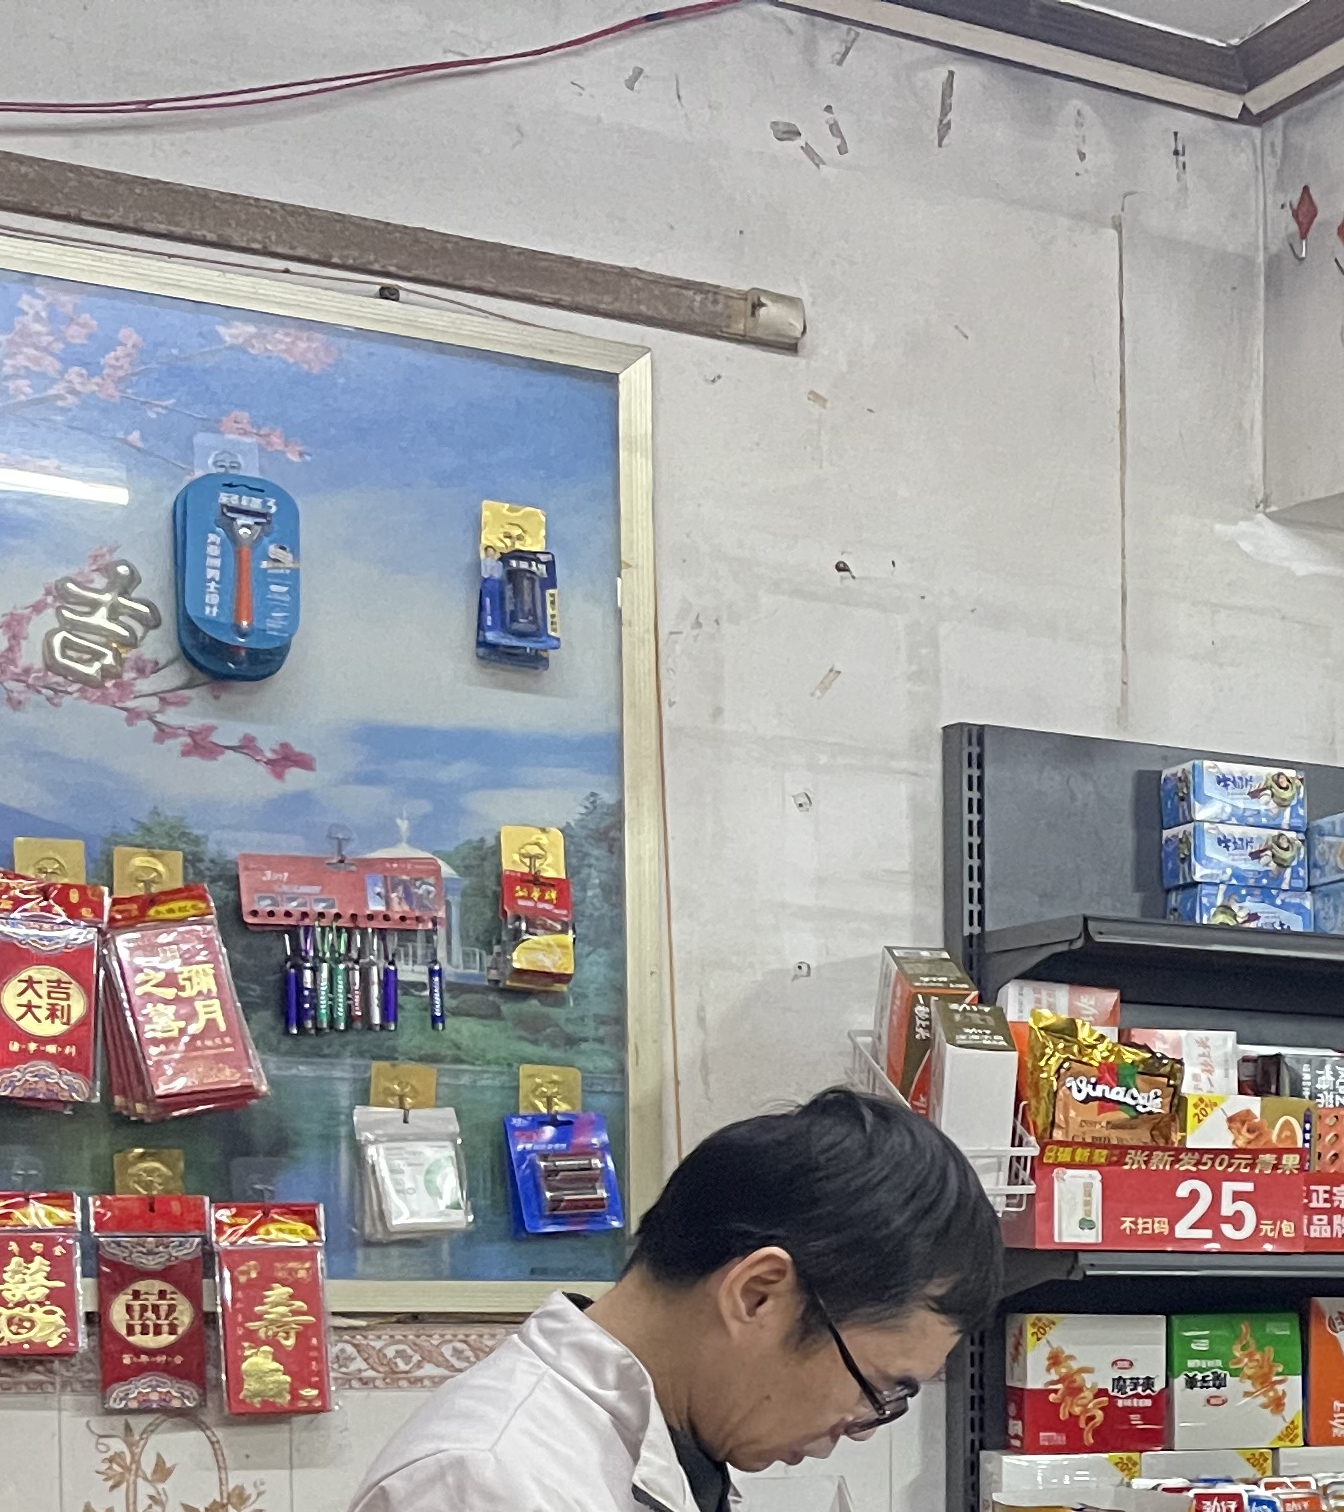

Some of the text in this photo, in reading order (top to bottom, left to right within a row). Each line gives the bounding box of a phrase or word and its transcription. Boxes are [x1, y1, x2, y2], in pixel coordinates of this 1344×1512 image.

[16, 974, 74, 1001] 大吉
[15, 1001, 73, 1026] 大利
[1123, 1149, 1301, 1174] 张新发50元青果
[1174, 1180, 1257, 1240] 25
[1120, 1217, 1170, 1236] 不扫码
[1259, 1220, 1296, 1238] 元/包
